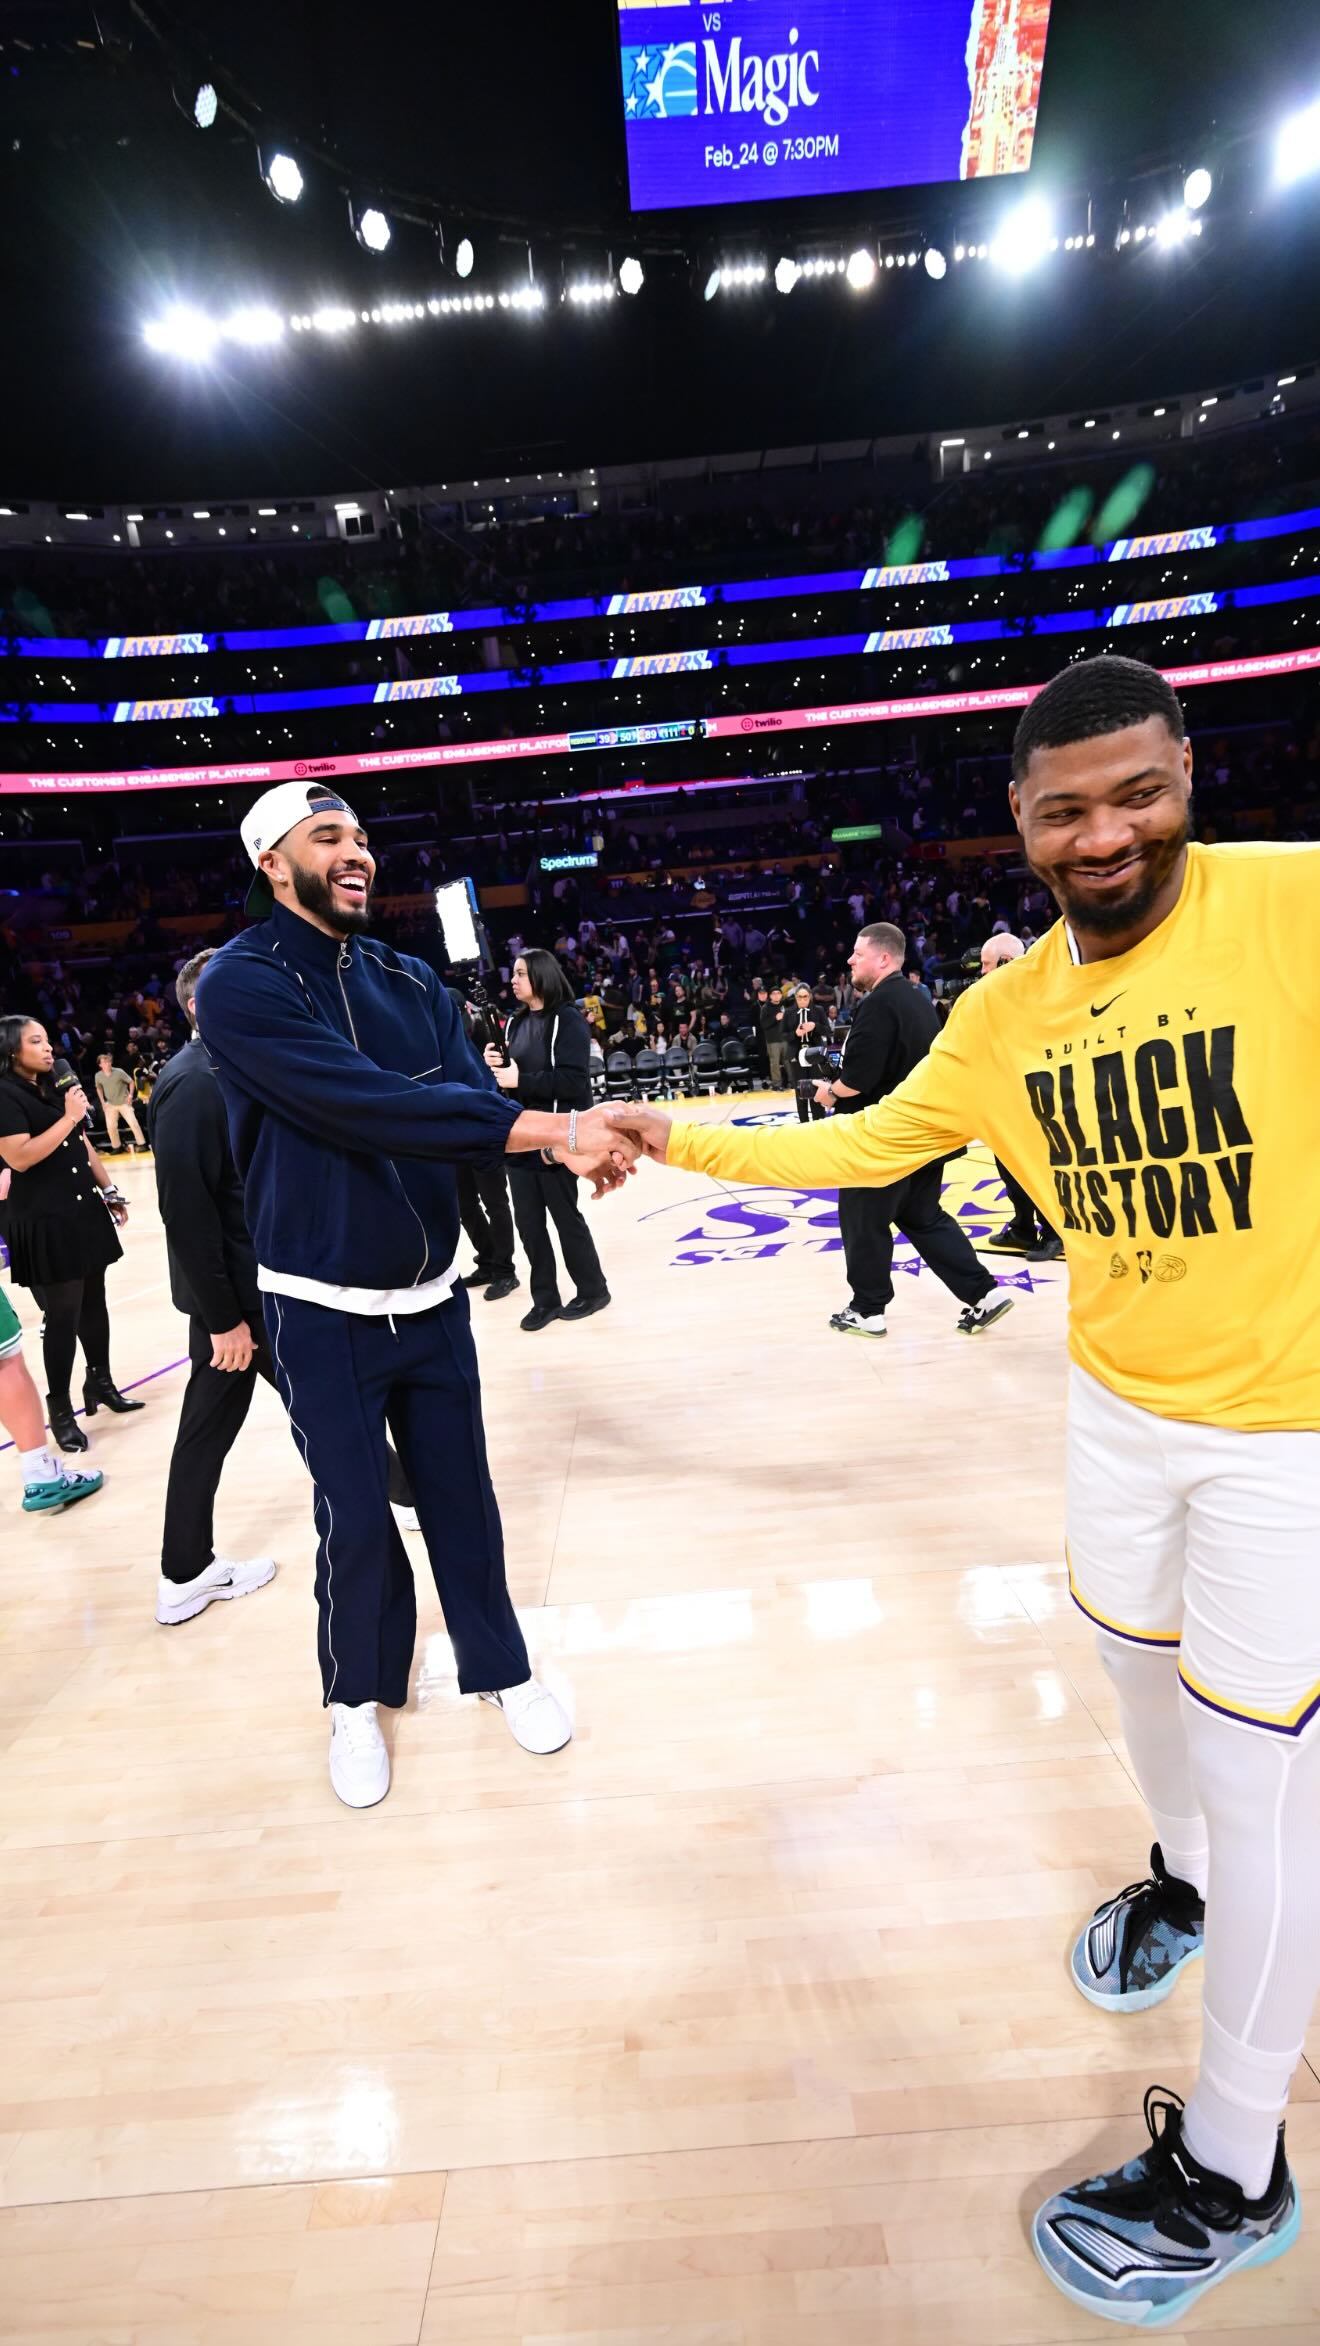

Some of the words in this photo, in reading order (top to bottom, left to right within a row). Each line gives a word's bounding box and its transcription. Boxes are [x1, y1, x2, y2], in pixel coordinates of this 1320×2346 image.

[702, 12, 721, 32] VS
[702, 27, 820, 126] Magic
[704, 142, 759, 169] Feb_24
[762, 141, 779, 166] @
[782, 134, 839, 161] 7:30PM
[1211, 656, 1295, 677] ENGAGEMENT
[805, 711, 828, 723] THE
[829, 704, 890, 721] CUSTOMER
[891, 698, 967, 715] ENGAGEMENT
[968, 690, 1028, 706] PLATFORM
[755, 717, 782, 728] twilio
[308, 762, 336, 773] twilio
[358, 757, 381, 768] THE
[382, 750, 441, 766] CUSTOMER
[443, 743, 519, 761] ENGAGEMENT
[28, 777, 56, 788] THE
[57, 776, 125, 788] CUSTOMER
[127, 771, 207, 785] ENGAGEMENT
[208, 767, 270, 780] PLATFORM
[540, 855, 593, 871] Spectrum
[1045, 1026, 1127, 1060] BUILT
[1157, 1007, 1198, 1027] BY
[1024, 1025, 1254, 1167] BLACK
[1054, 1152, 1254, 1239] HISTORY
